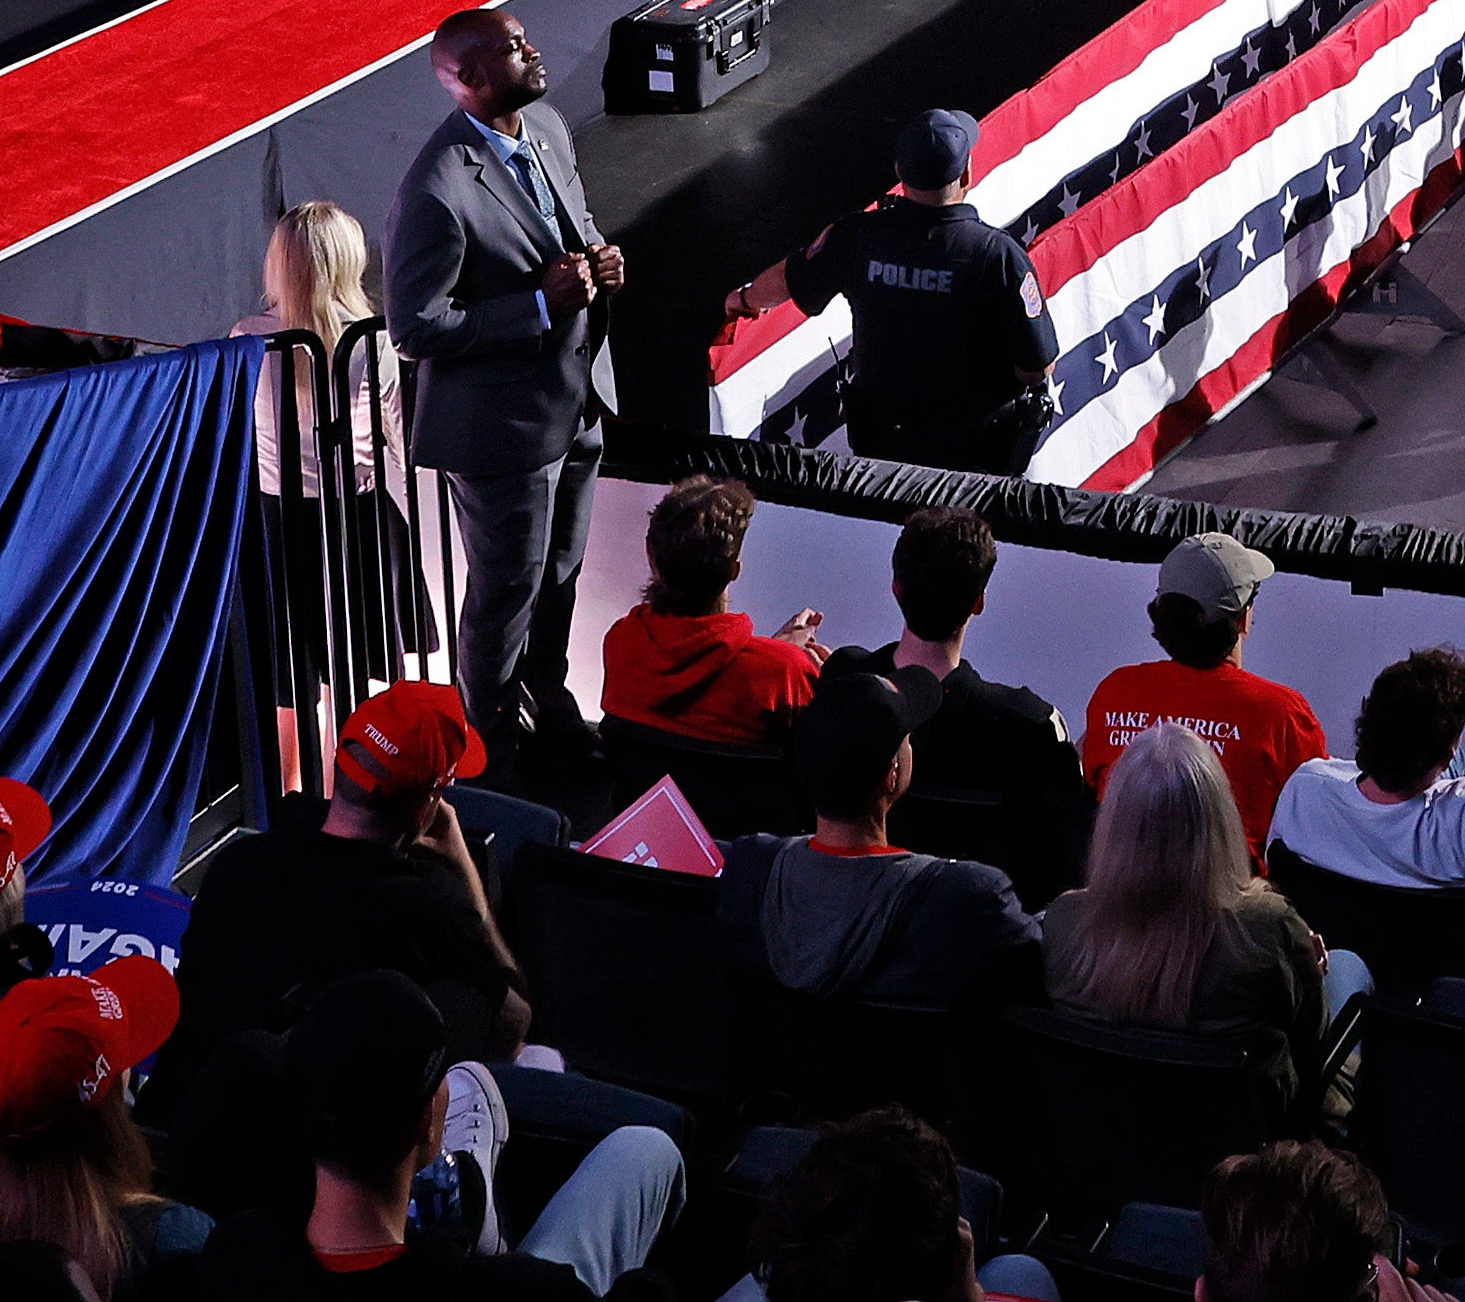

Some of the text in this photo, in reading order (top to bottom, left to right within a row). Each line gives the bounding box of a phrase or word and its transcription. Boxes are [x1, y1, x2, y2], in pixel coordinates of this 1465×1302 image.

[868, 259, 954, 293] POLICE
[364, 723, 400, 757] TRUMP
[1105, 711, 1241, 742] MAKE AMERICA
[90, 879, 139, 897] 2024
